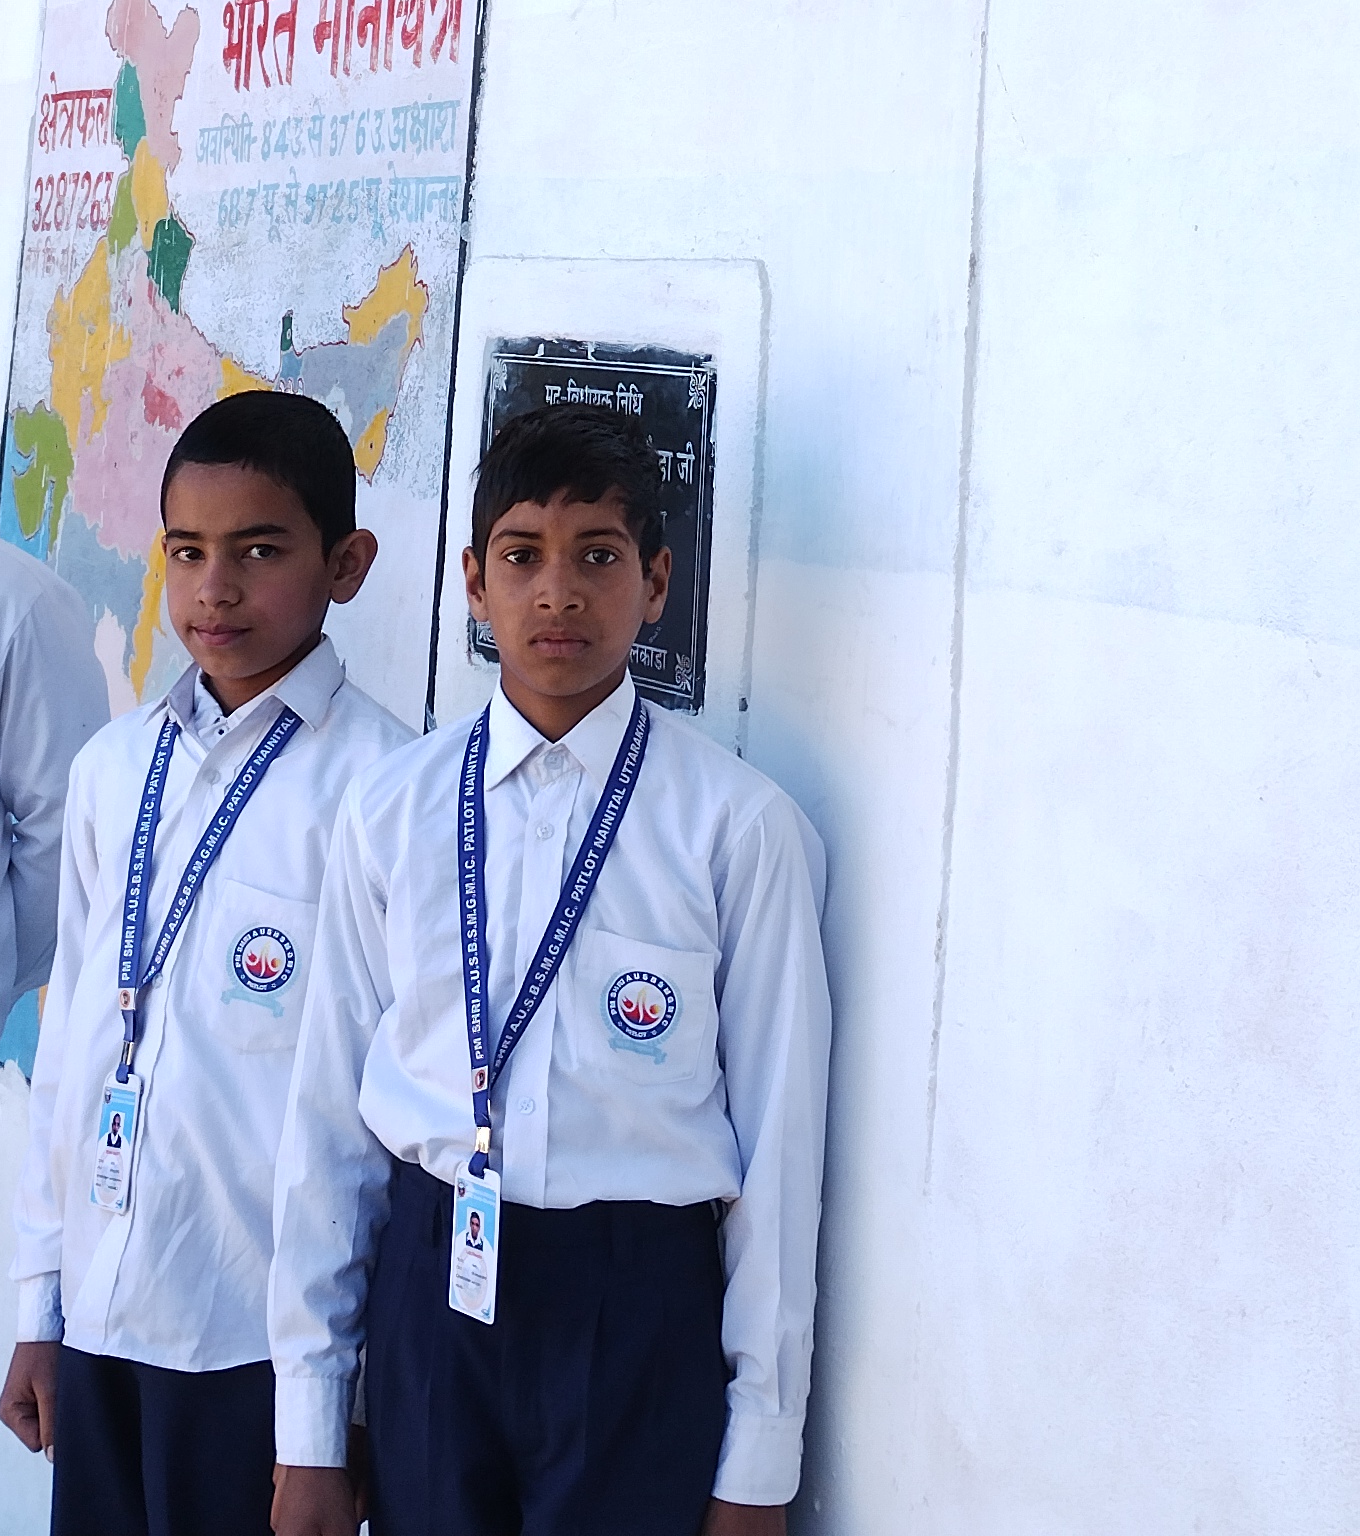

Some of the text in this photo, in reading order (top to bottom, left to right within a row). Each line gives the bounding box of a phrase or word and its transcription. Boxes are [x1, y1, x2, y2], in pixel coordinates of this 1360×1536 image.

[38, 71, 113, 154] क्षेत्रफल
[31, 171, 114, 232] 3287263
[676, 441, 695, 484] जी
[147, 750, 168, 796] PATLOT
[464, 736, 481, 797] NAINITAL
[154, 931, 172, 965] SHRI
[226, 767, 257, 813] PATLOT
[252, 715, 297, 766] NAINITAL
[463, 800, 475, 852] PATLOT
[571, 849, 600, 903] PATLOT
[593, 787, 627, 849] NAINITAL
[123, 925, 136, 961] SHRI
[122, 965, 133, 981] PM
[471, 999, 482, 1034] SHRI
[474, 1037, 485, 1060] PM
